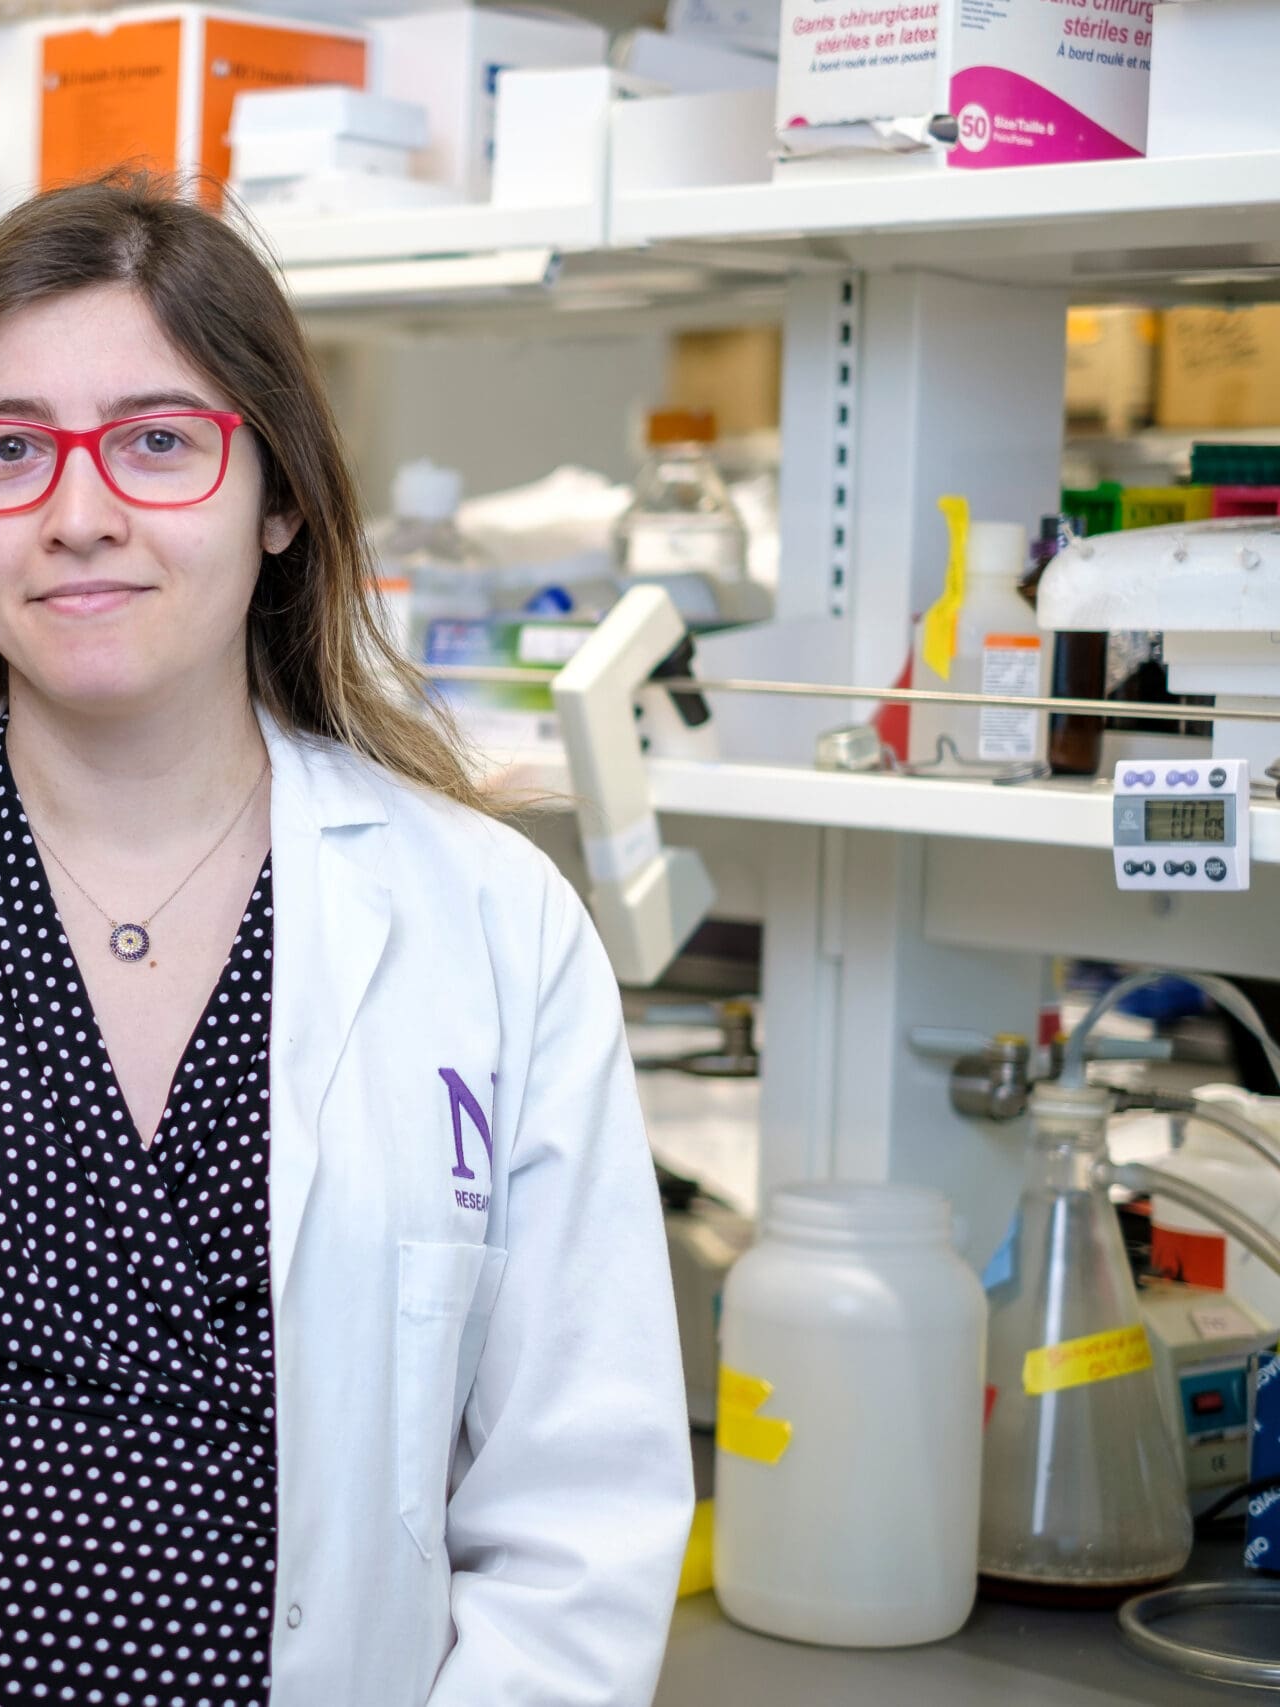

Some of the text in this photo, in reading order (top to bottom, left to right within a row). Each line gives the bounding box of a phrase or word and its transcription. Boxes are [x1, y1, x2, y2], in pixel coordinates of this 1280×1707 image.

[792, 15, 836, 36] Gants
[839, 2, 939, 29] chirurgicaux
[1063, 16, 1129, 44] stériles
[875, 33, 895, 48] en
[899, 26, 939, 45] latex
[1068, 44, 1094, 63] bord
[1096, 51, 1124, 67] roulé
[1126, 56, 1138, 69] et
[962, 115, 986, 139] 50
[438, 1067, 497, 1181] N
